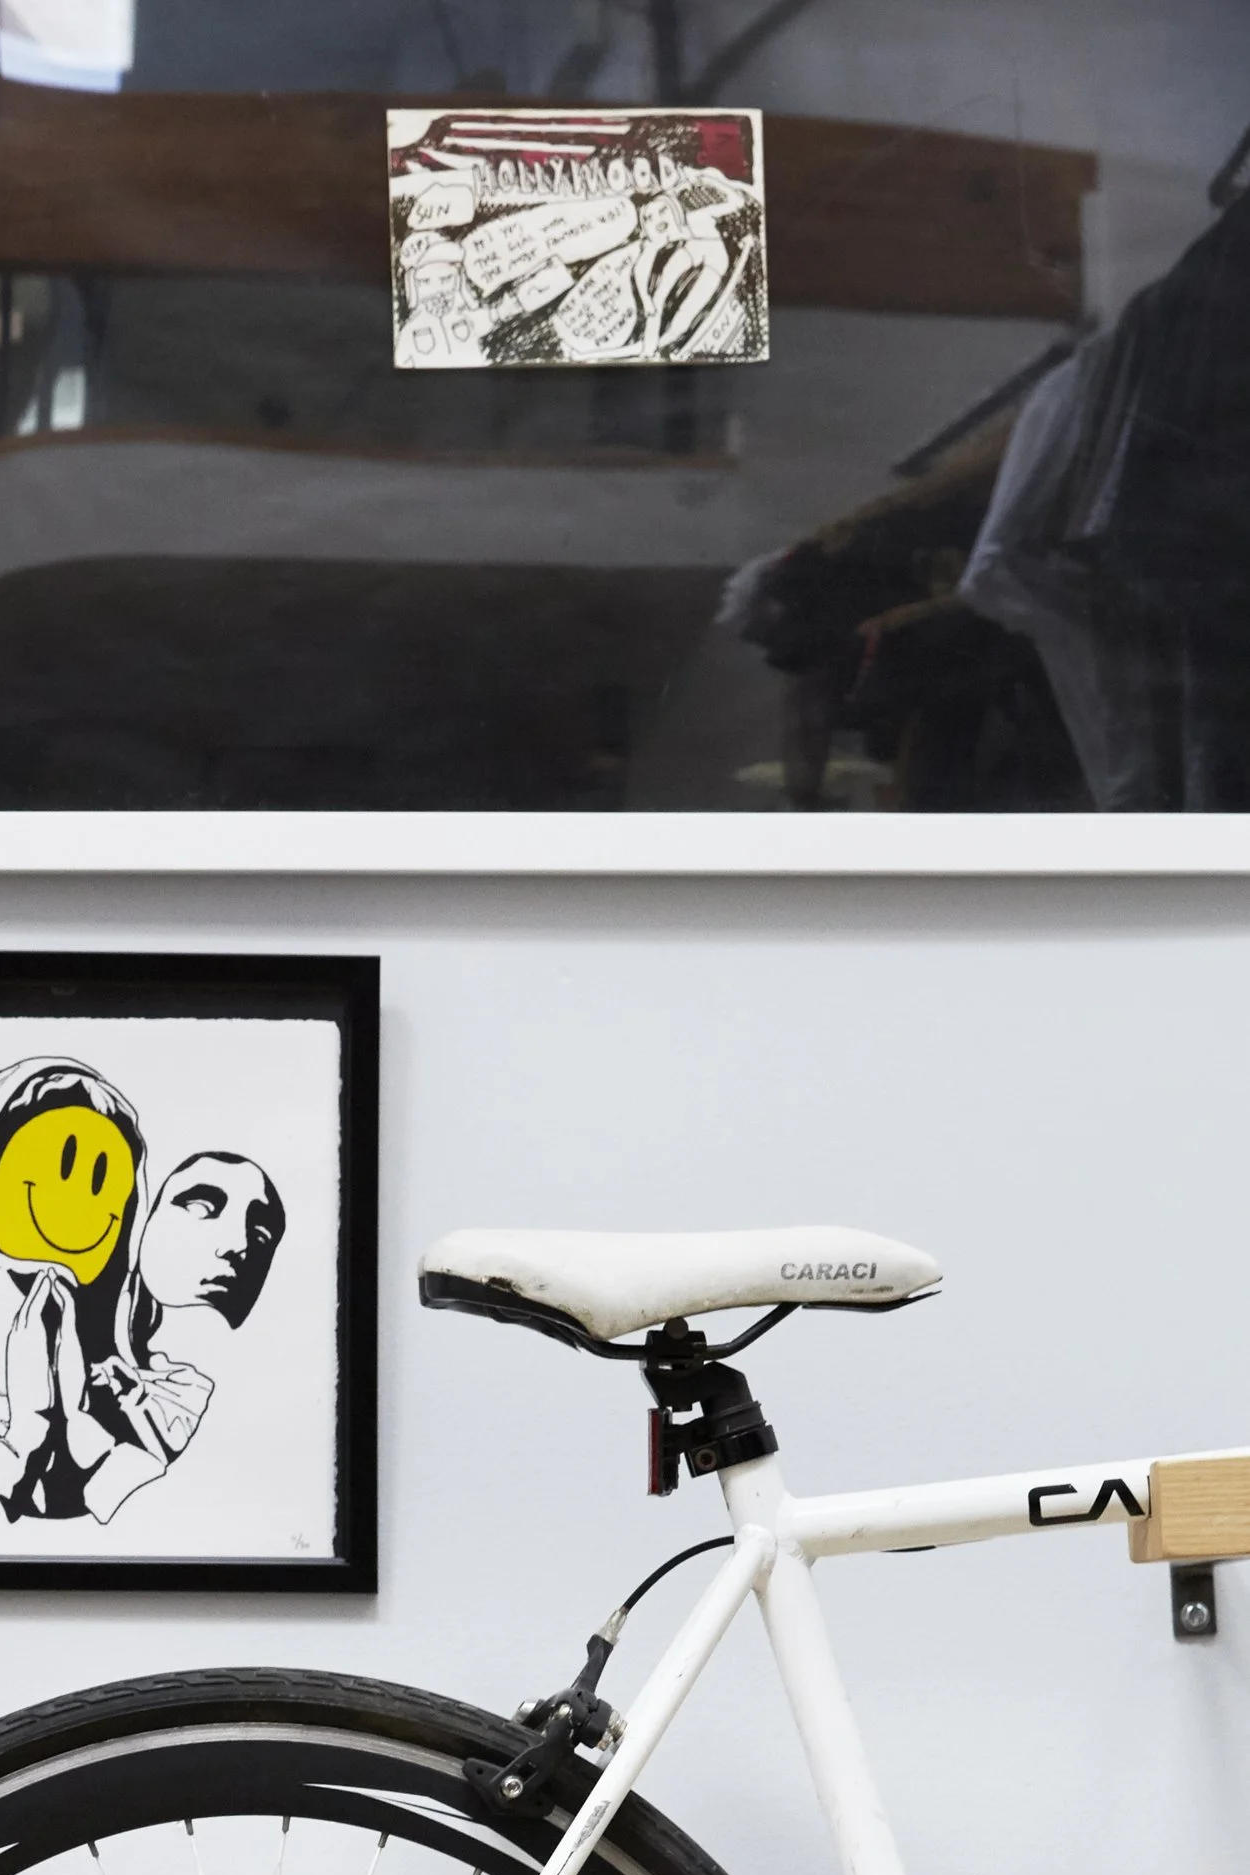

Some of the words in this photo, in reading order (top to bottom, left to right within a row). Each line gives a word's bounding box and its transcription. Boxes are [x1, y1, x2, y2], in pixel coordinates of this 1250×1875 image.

[472, 157, 683, 197] HOLLYWOOD
[780, 1259, 879, 1282] CARACI
[1027, 1476, 1152, 1527] CA
